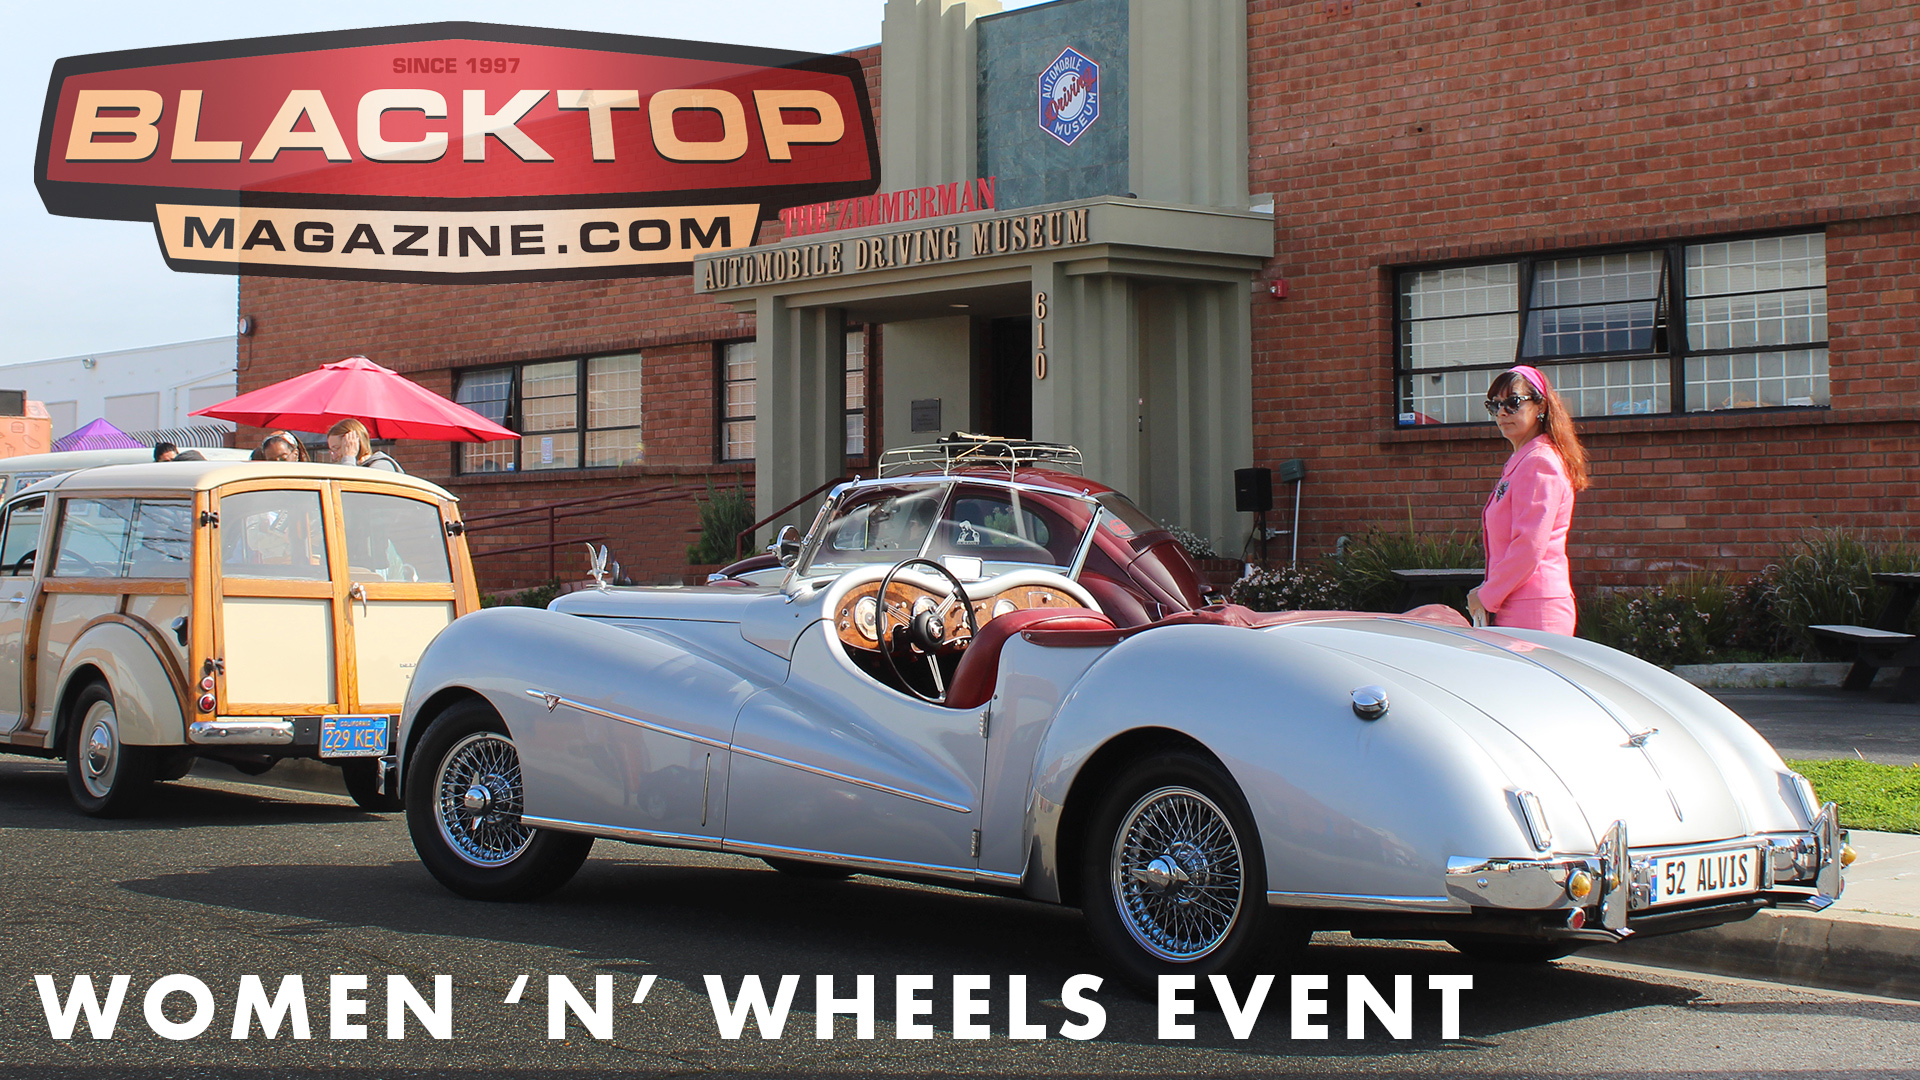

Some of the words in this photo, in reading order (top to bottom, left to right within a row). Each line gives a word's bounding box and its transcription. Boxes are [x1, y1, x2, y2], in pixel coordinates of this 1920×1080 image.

[1042, 56, 1083, 99] AUTOMOBILE
[1044, 66, 1098, 127] Driving
[1054, 92, 1097, 136] MUSEUM
[779, 201, 831, 238] THE
[834, 175, 997, 231] ZIMMERMAN
[703, 242, 842, 290] AUTOMOBILE
[854, 225, 959, 272] DRIVING
[970, 208, 1089, 257] MUSEUM
[1034, 290, 1047, 381] 610
[324, 729, 351, 749] 229
[354, 729, 384, 748] KEK
[1666, 860, 1686, 896] 52
[1697, 853, 1748, 892] ALVIS
